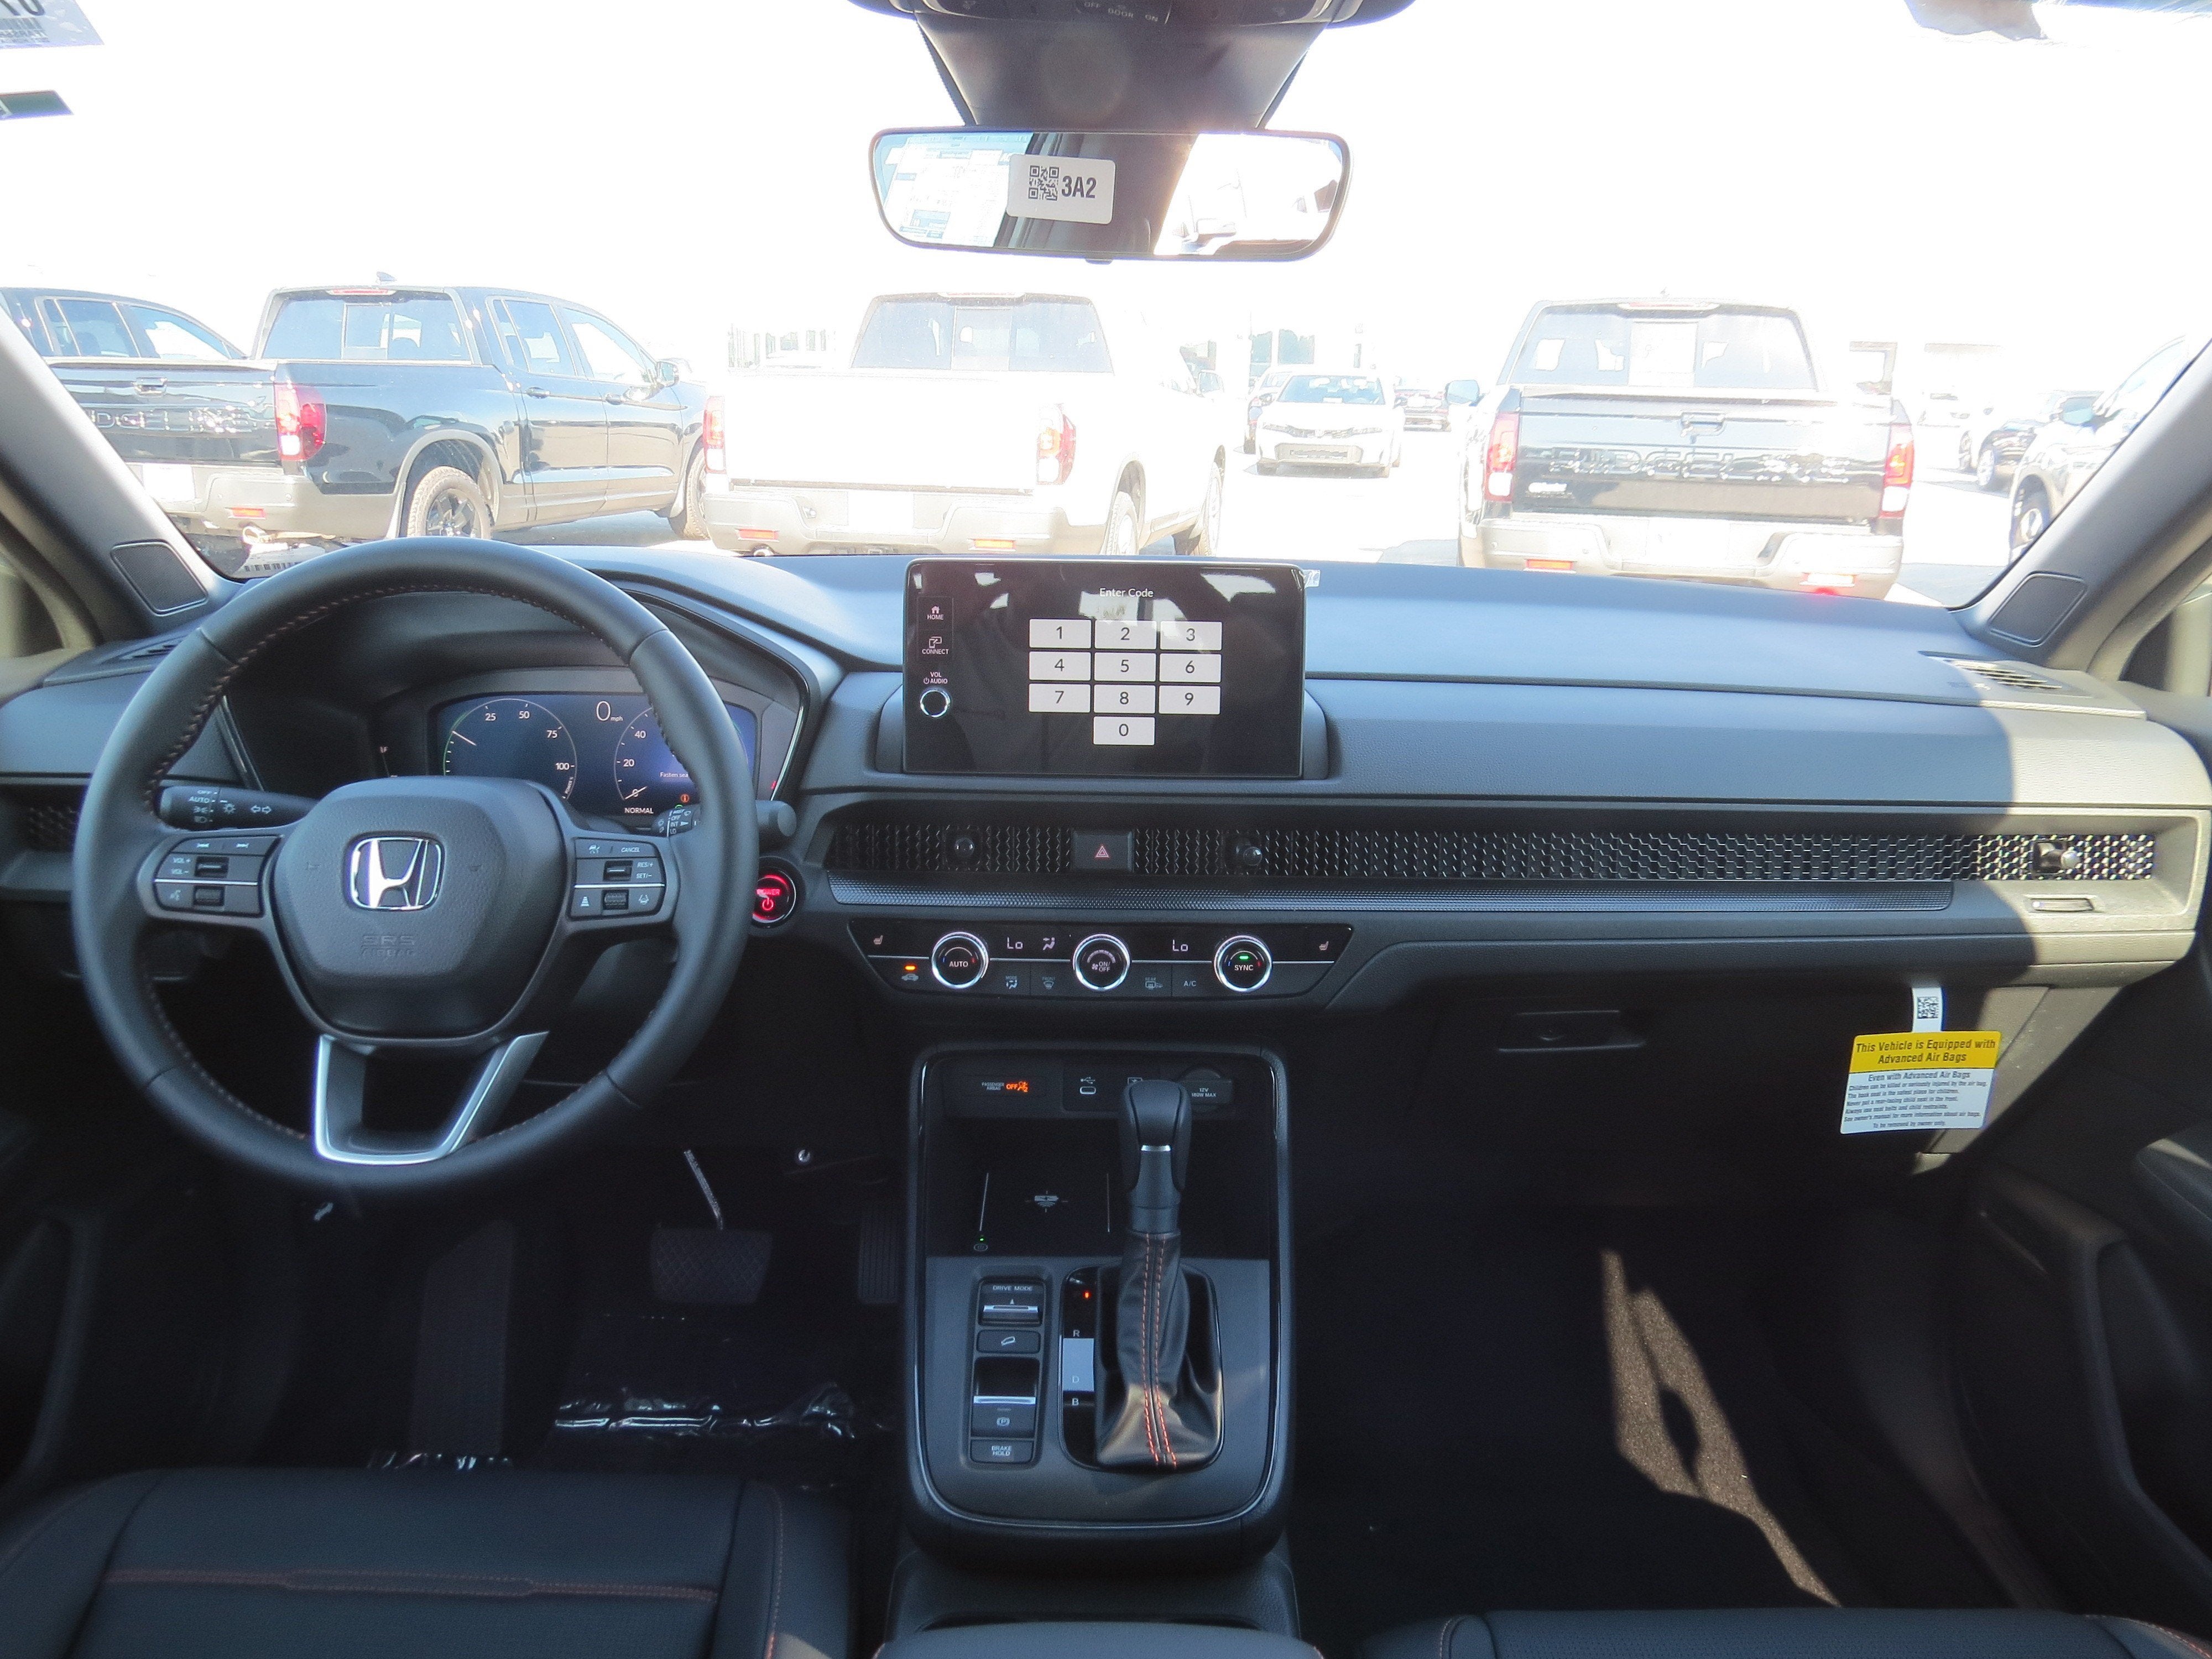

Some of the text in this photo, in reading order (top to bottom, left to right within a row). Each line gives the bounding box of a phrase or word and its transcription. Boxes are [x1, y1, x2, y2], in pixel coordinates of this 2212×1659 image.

[1061, 175, 1097, 199] 3A2
[1099, 588, 1154, 598] Enter Code
[1056, 626, 1196, 641] 1 2 3
[1055, 658, 1195, 674] 4 5 6
[1055, 690, 1194, 706] 7 8 9
[518, 711, 530, 719] 50
[596, 701, 611, 721] 0
[484, 713, 497, 721] 25
[546, 730, 558, 738] 75
[634, 730, 646, 739] 40
[1119, 723, 1129, 737] 0
[555, 762, 570, 770] 100
[623, 759, 635, 767] 20
[1006, 937, 1023, 950] Lo
[1172, 939, 1188, 951] Lo
[1856, 1039, 1996, 1053] This Vehicle is Equipped with
[1877, 1052, 1967, 1064] Advanced Air Bags
[1952, 1071, 1970, 1079] Bags
[1072, 1329, 1080, 1338] R
[1072, 1397, 1079, 1406] B
